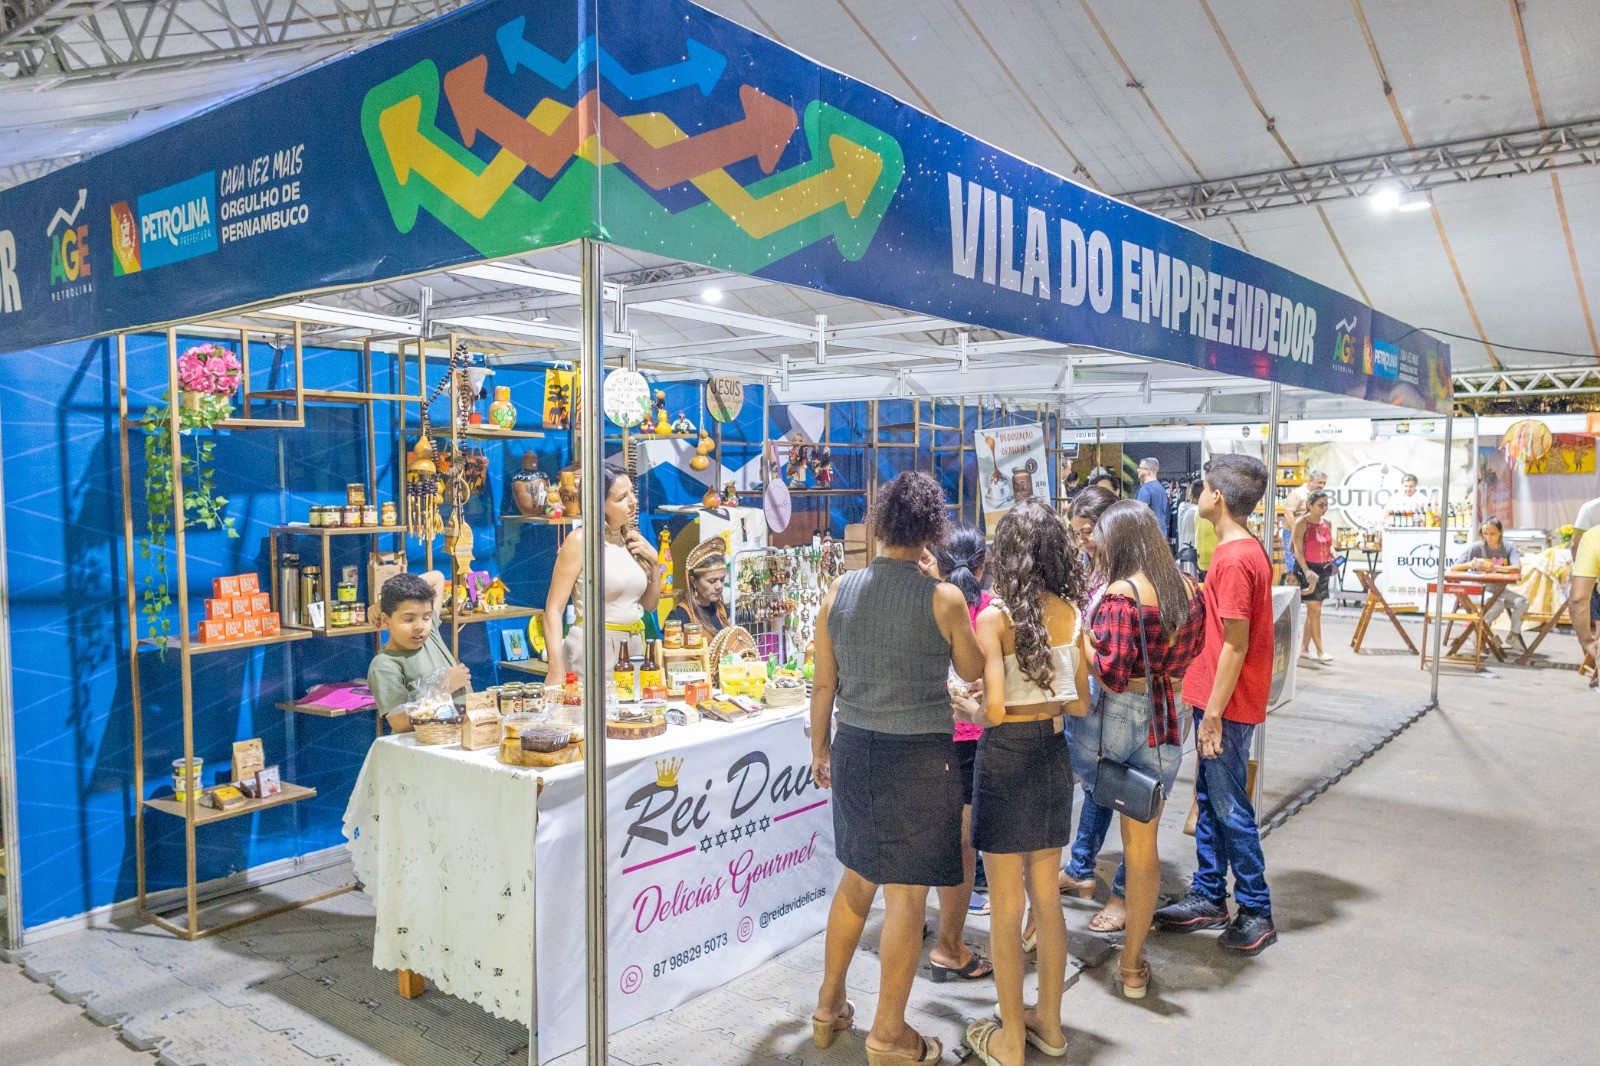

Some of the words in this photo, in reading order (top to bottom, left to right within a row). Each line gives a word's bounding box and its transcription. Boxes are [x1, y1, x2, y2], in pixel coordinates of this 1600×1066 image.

[220, 168, 245, 197] CADA
[247, 158, 269, 190] VEZ
[273, 144, 305, 180] MAIS
[142, 196, 210, 246] PETROLINA
[220, 187, 280, 221] ORGULHO
[282, 182, 301, 204] DE
[221, 204, 309, 244] PERNAMBUCO
[50, 225, 92, 286] AGE
[179, 230, 213, 247] PREFEITURA
[51, 283, 94, 302] PETROLINA
[946, 172, 1051, 300] VILA
[1060, 218, 1113, 314] DO
[1121, 240, 1318, 366] EMPREENDEDOR
[710, 379, 741, 397] JESUS
[620, 779, 713, 858] Rei
[727, 750, 821, 820] Dav
[728, 831, 821, 908] Gourmet
[653, 960, 667, 978] 87
[669, 944, 702, 971] 98829
[704, 932, 728, 955] 5073
[759, 886, 827, 929] @reidavidelicias
